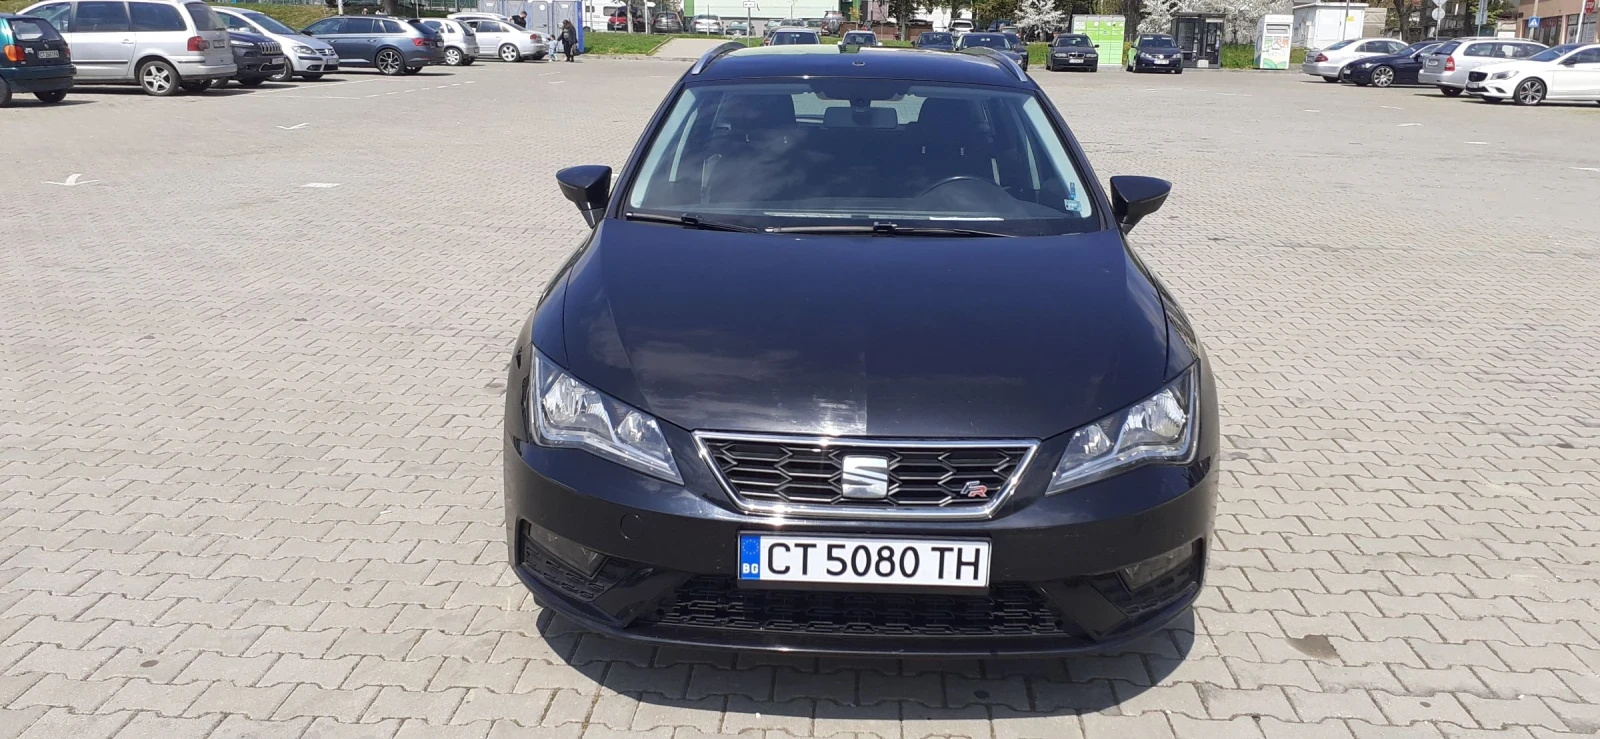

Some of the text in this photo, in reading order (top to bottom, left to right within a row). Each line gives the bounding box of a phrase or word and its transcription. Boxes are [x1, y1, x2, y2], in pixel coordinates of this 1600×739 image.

[742, 563, 759, 574] BG
[767, 542, 981, 580] CT 5080 TH
